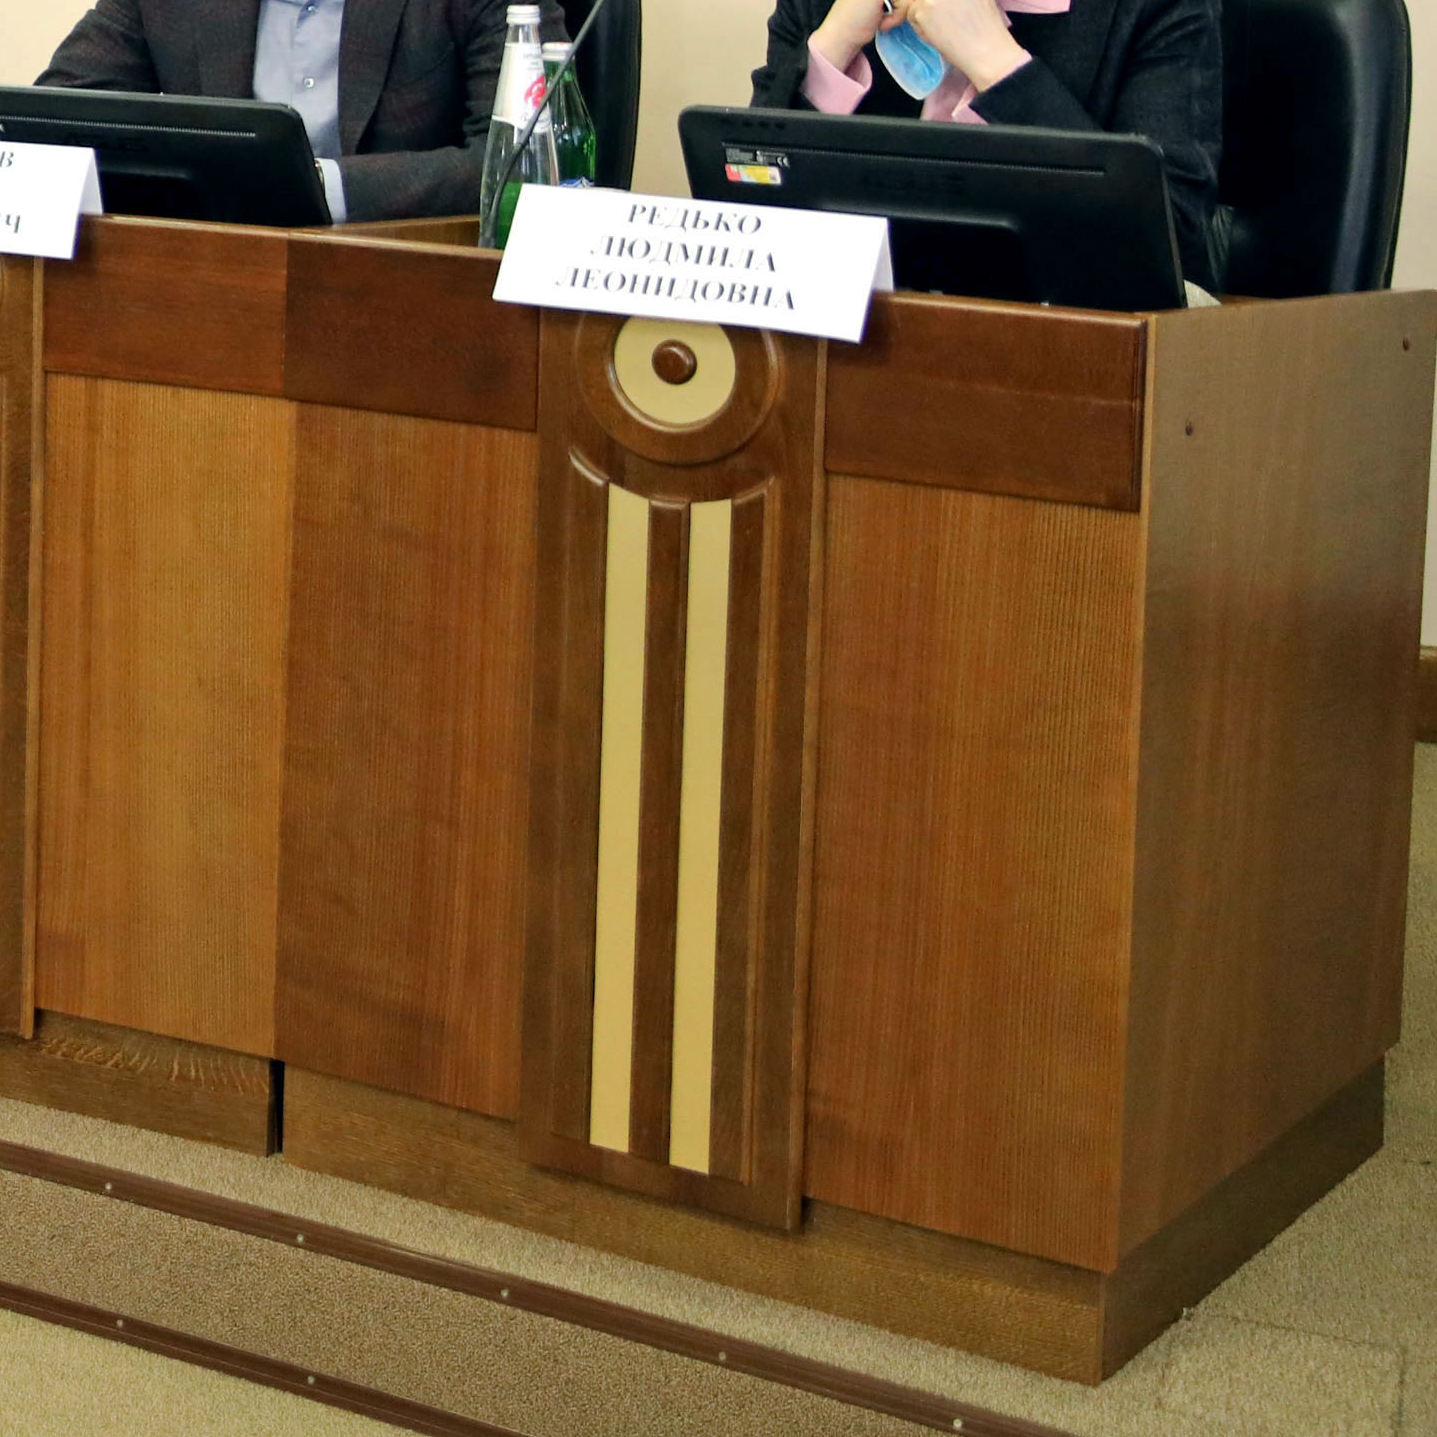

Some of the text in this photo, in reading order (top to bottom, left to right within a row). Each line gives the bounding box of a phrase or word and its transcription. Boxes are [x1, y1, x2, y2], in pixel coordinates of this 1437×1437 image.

[627, 203, 763, 235] РЕДЬКО
[589, 234, 777, 273] ЛЮДМИЛА
[554, 266, 796, 311] ЛЕОНИДОВНА
